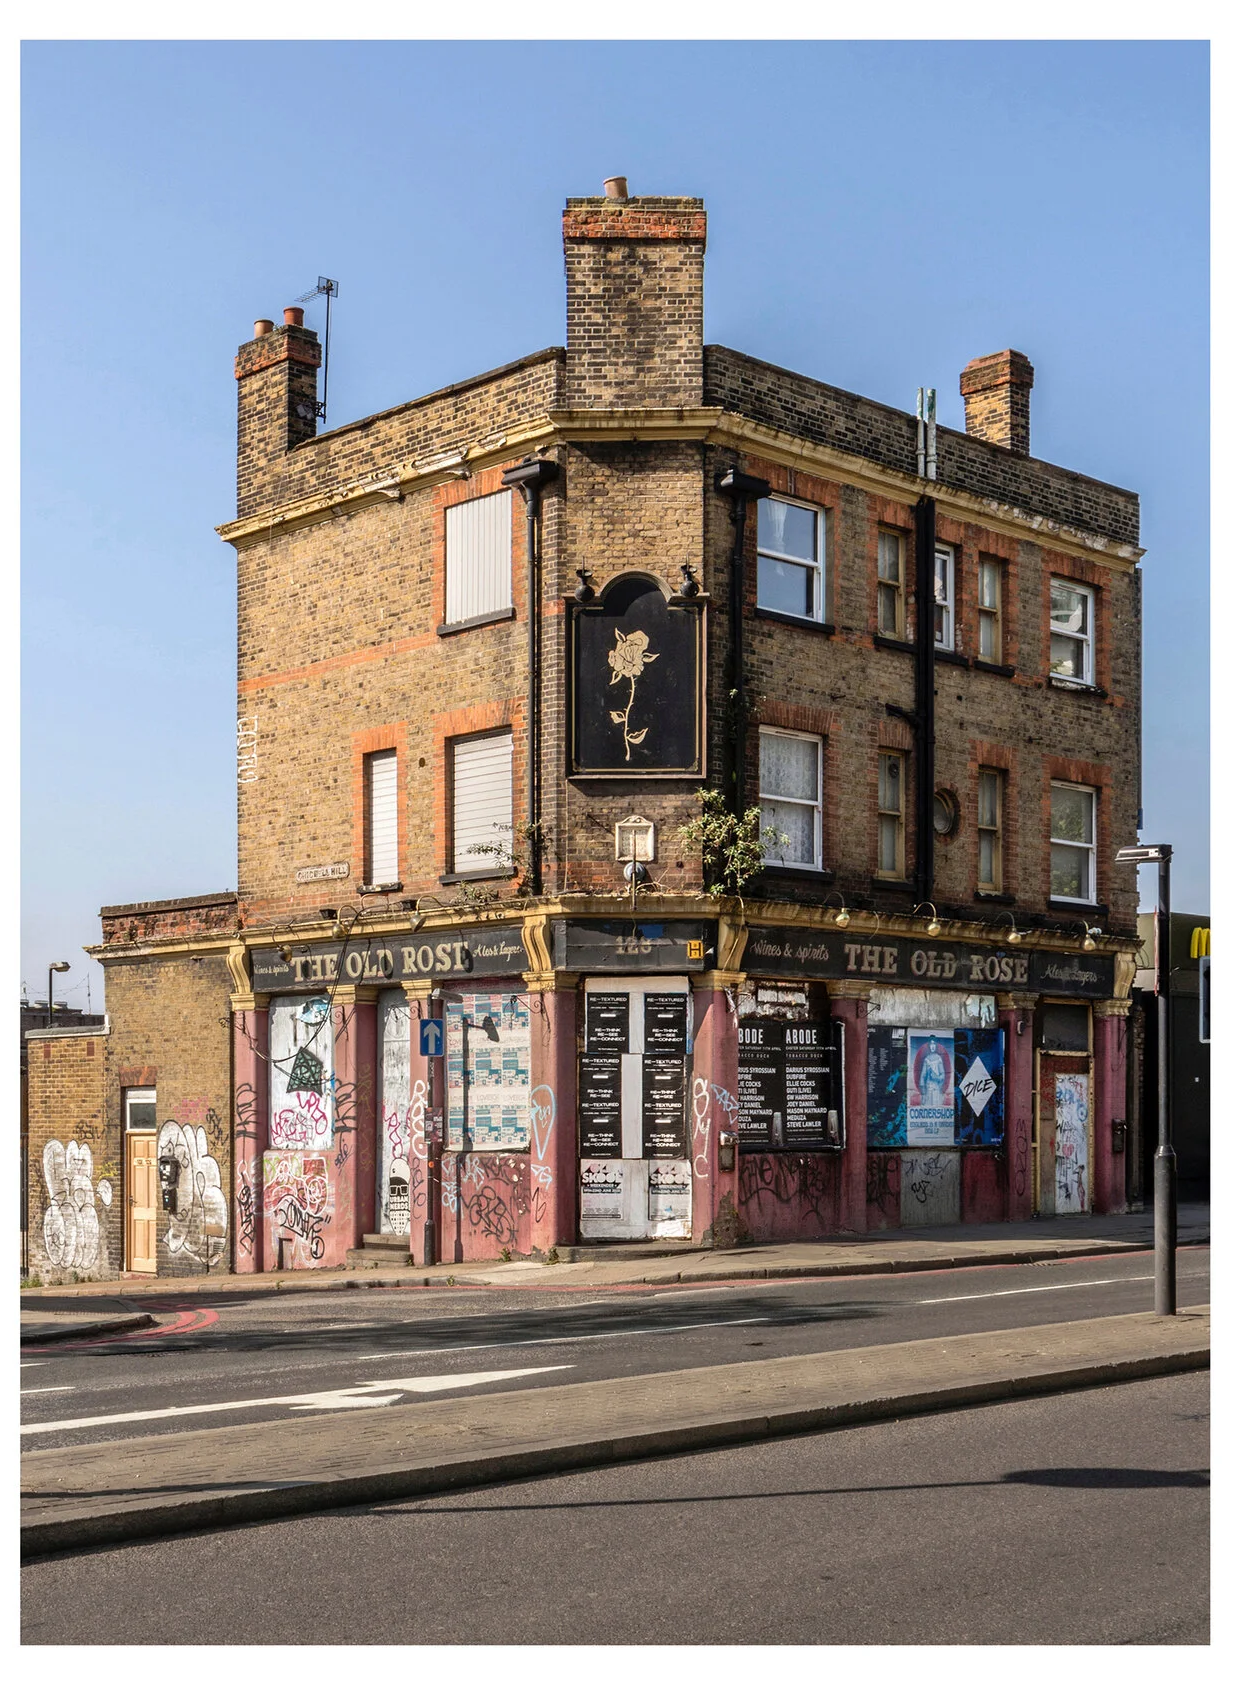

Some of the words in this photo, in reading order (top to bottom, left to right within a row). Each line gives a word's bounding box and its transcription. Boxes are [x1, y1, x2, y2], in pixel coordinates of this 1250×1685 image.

[750, 940, 782, 957] Wines
[783, 943, 793, 957] &
[796, 944, 829, 963] spirits
[291, 953, 338, 983] THE
[345, 949, 394, 979] OLD
[844, 944, 898, 974] THE
[910, 950, 957, 978] OLD
[970, 954, 1029, 984] ROSE
[738, 1028, 763, 1044] BODE
[786, 1029, 817, 1044] ABODE
[964, 1078, 993, 1097] DICE
[910, 1108, 954, 1119] CORNERSHOP
